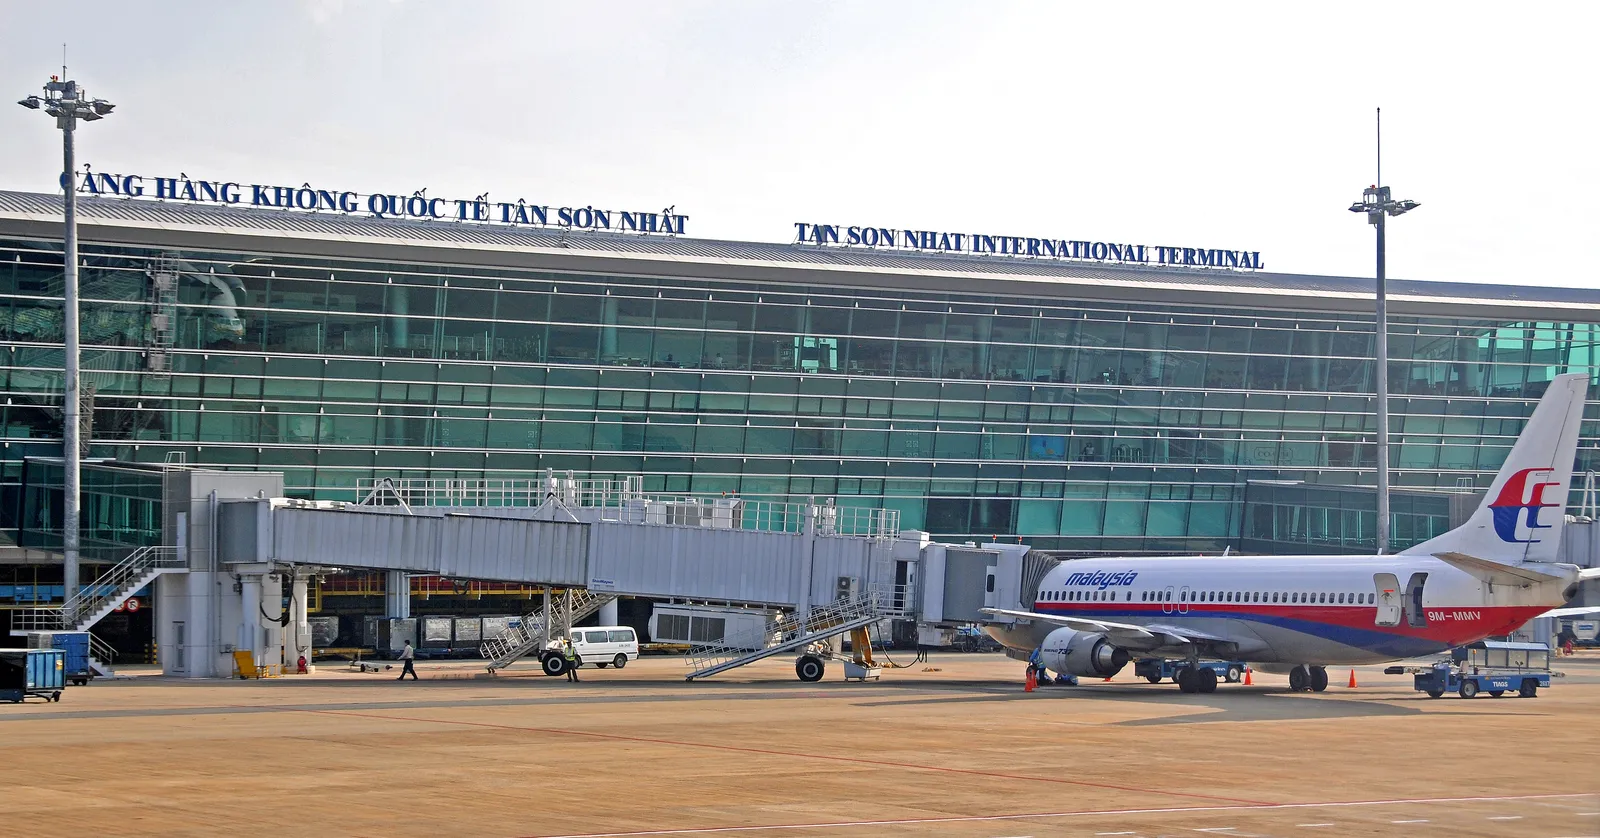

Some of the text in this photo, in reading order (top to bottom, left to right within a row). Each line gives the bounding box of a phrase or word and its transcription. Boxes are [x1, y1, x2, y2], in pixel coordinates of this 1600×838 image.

[154, 172, 240, 204] HÀNG
[251, 182, 359, 213] KHÔNG
[367, 187, 446, 219] QUỐC
[455, 192, 490, 221] TẾ
[497, 198, 549, 226] TÂN
[558, 205, 612, 231] SƠN
[620, 204, 690, 235] NHẤT
[794, 222, 1265, 270] TAN SON NHAT INTERNATIONAL TERMINAL
[1065, 569, 1138, 590] malaysia
[1427, 611, 1481, 621] 9M-MMV
